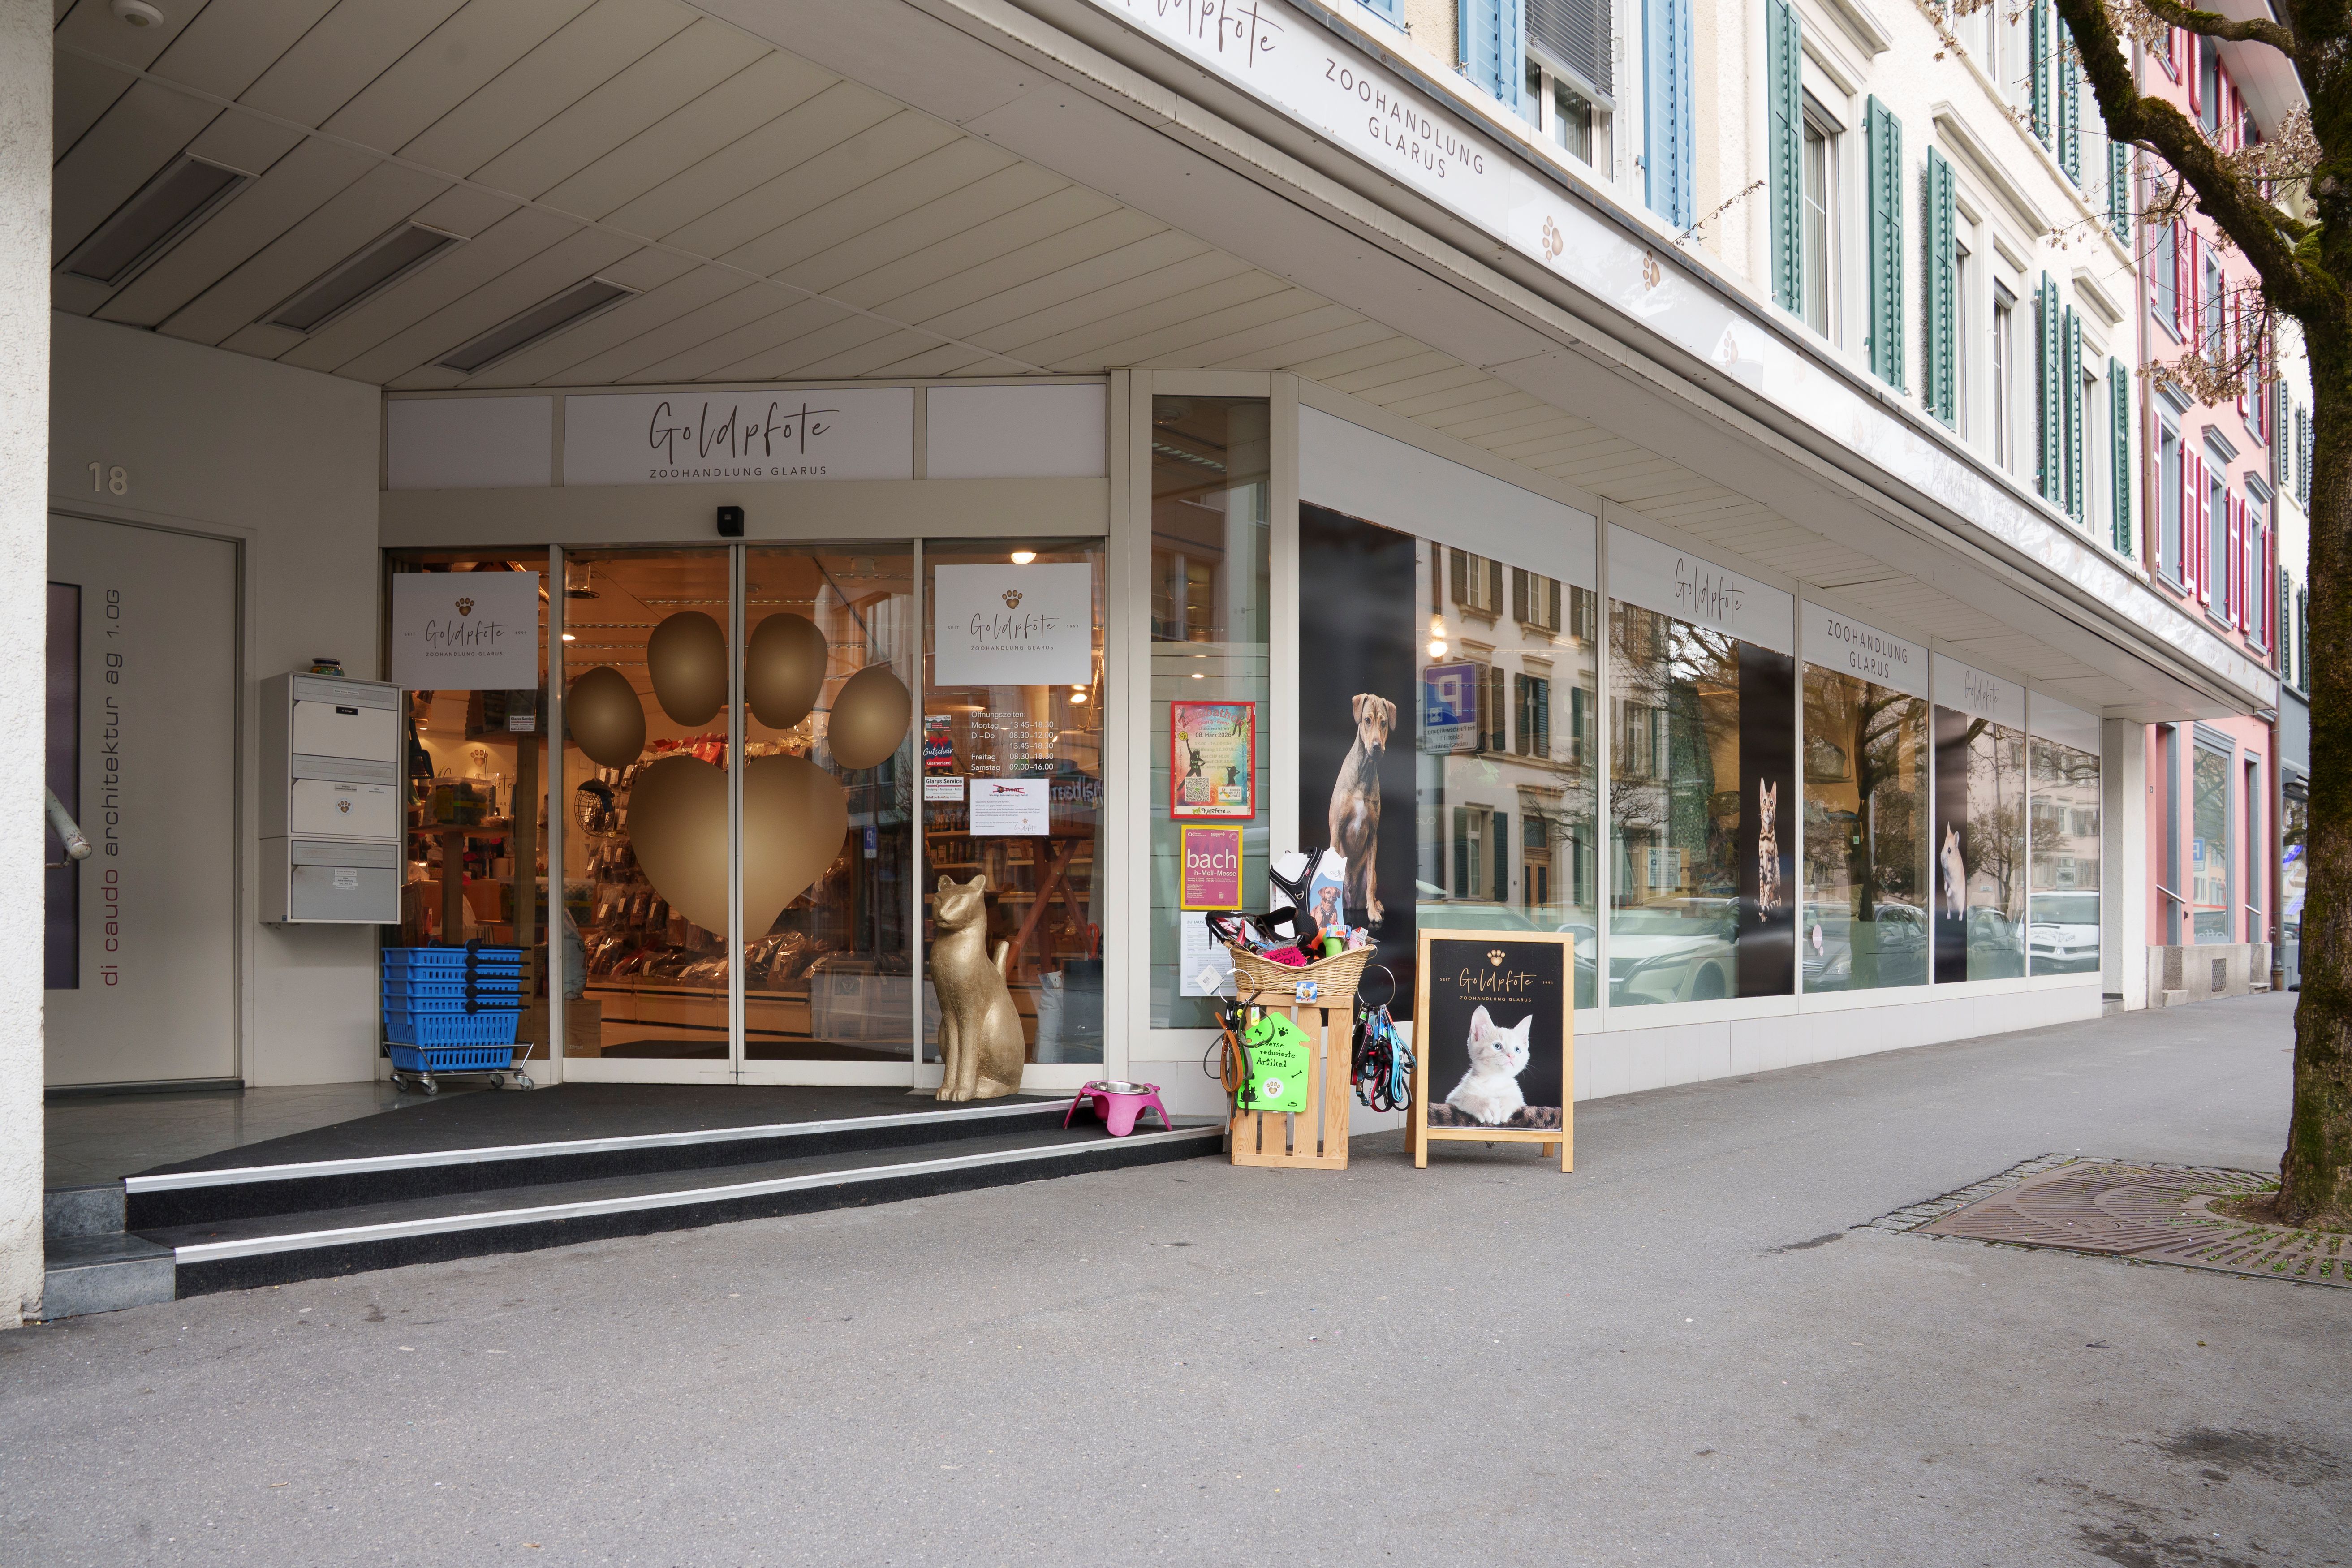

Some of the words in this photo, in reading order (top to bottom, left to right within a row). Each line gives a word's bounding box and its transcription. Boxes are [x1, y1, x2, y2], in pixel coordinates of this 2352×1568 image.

[1327, 58, 1484, 175] ZOOHANDLUNG
[1369, 117, 1445, 178] GLARUS
[650, 401, 840, 465] Goldpfote
[88, 462, 128, 495] 18
[650, 467, 762, 478] ZOOHANDLUNG
[771, 466, 826, 475] GLARUS
[1675, 558, 1745, 624] Goldpfote
[426, 620, 508, 649] Goldpfote
[970, 613, 1060, 642] Goldpfote
[1827, 619, 1908, 663] ZOOHANDLUNG
[106, 652, 123, 684] ag
[1849, 651, 1889, 679] GLARUS
[1964, 670, 1999, 713] Goldpfote
[971, 722, 999, 730] Montag
[1178, 706, 1245, 728] Zumbathon
[971, 753, 996, 762] Freitag
[971, 764, 1000, 772] Samstag
[101, 697, 119, 857] architektur
[1187, 848, 1236, 869] bach
[101, 870, 118, 952] caudo
[1269, 948, 1294, 960] AKTION
[101, 965, 118, 986] di
[1460, 968, 1537, 994] Goldpfote
[1256, 1057, 1287, 1068] Artikel
[1259, 1049, 1296, 1059] reduzierte
